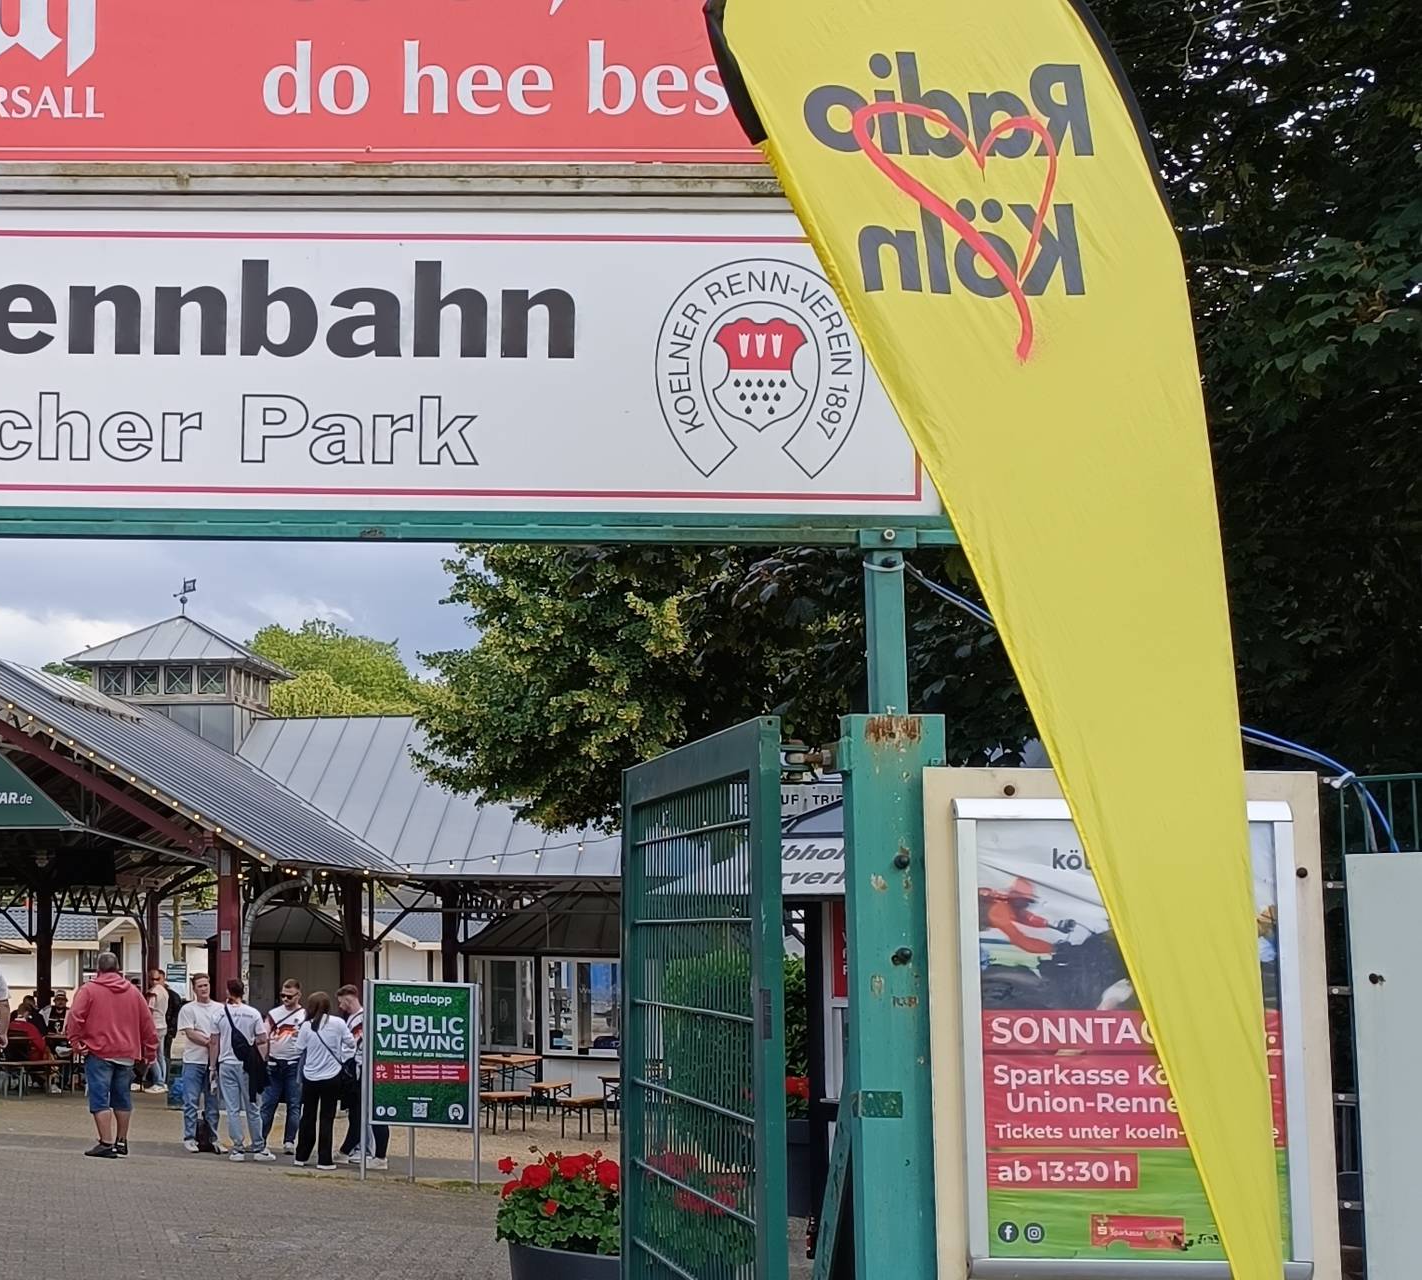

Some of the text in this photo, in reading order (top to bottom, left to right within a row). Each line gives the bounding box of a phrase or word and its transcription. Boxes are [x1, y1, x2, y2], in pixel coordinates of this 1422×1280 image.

[263, 40, 369, 115] do
[403, 40, 553, 115] hee
[668, 270, 853, 440] KOELNER RENN-VEREIN 1897
[241, 394, 479, 466] Park
[389, 991, 453, 1007] kölngalopp
[376, 1013, 465, 1035] PUBLIC
[376, 1033, 465, 1051] VIEWING
[993, 1064, 1130, 1089] Sparkasse
[1006, 1092, 1180, 1114] Union-Renne
[995, 1124, 1063, 1139] Tickets
[1069, 1125, 1118, 1139] unter
[998, 1161, 1131, 1182] ab 13:30 h
